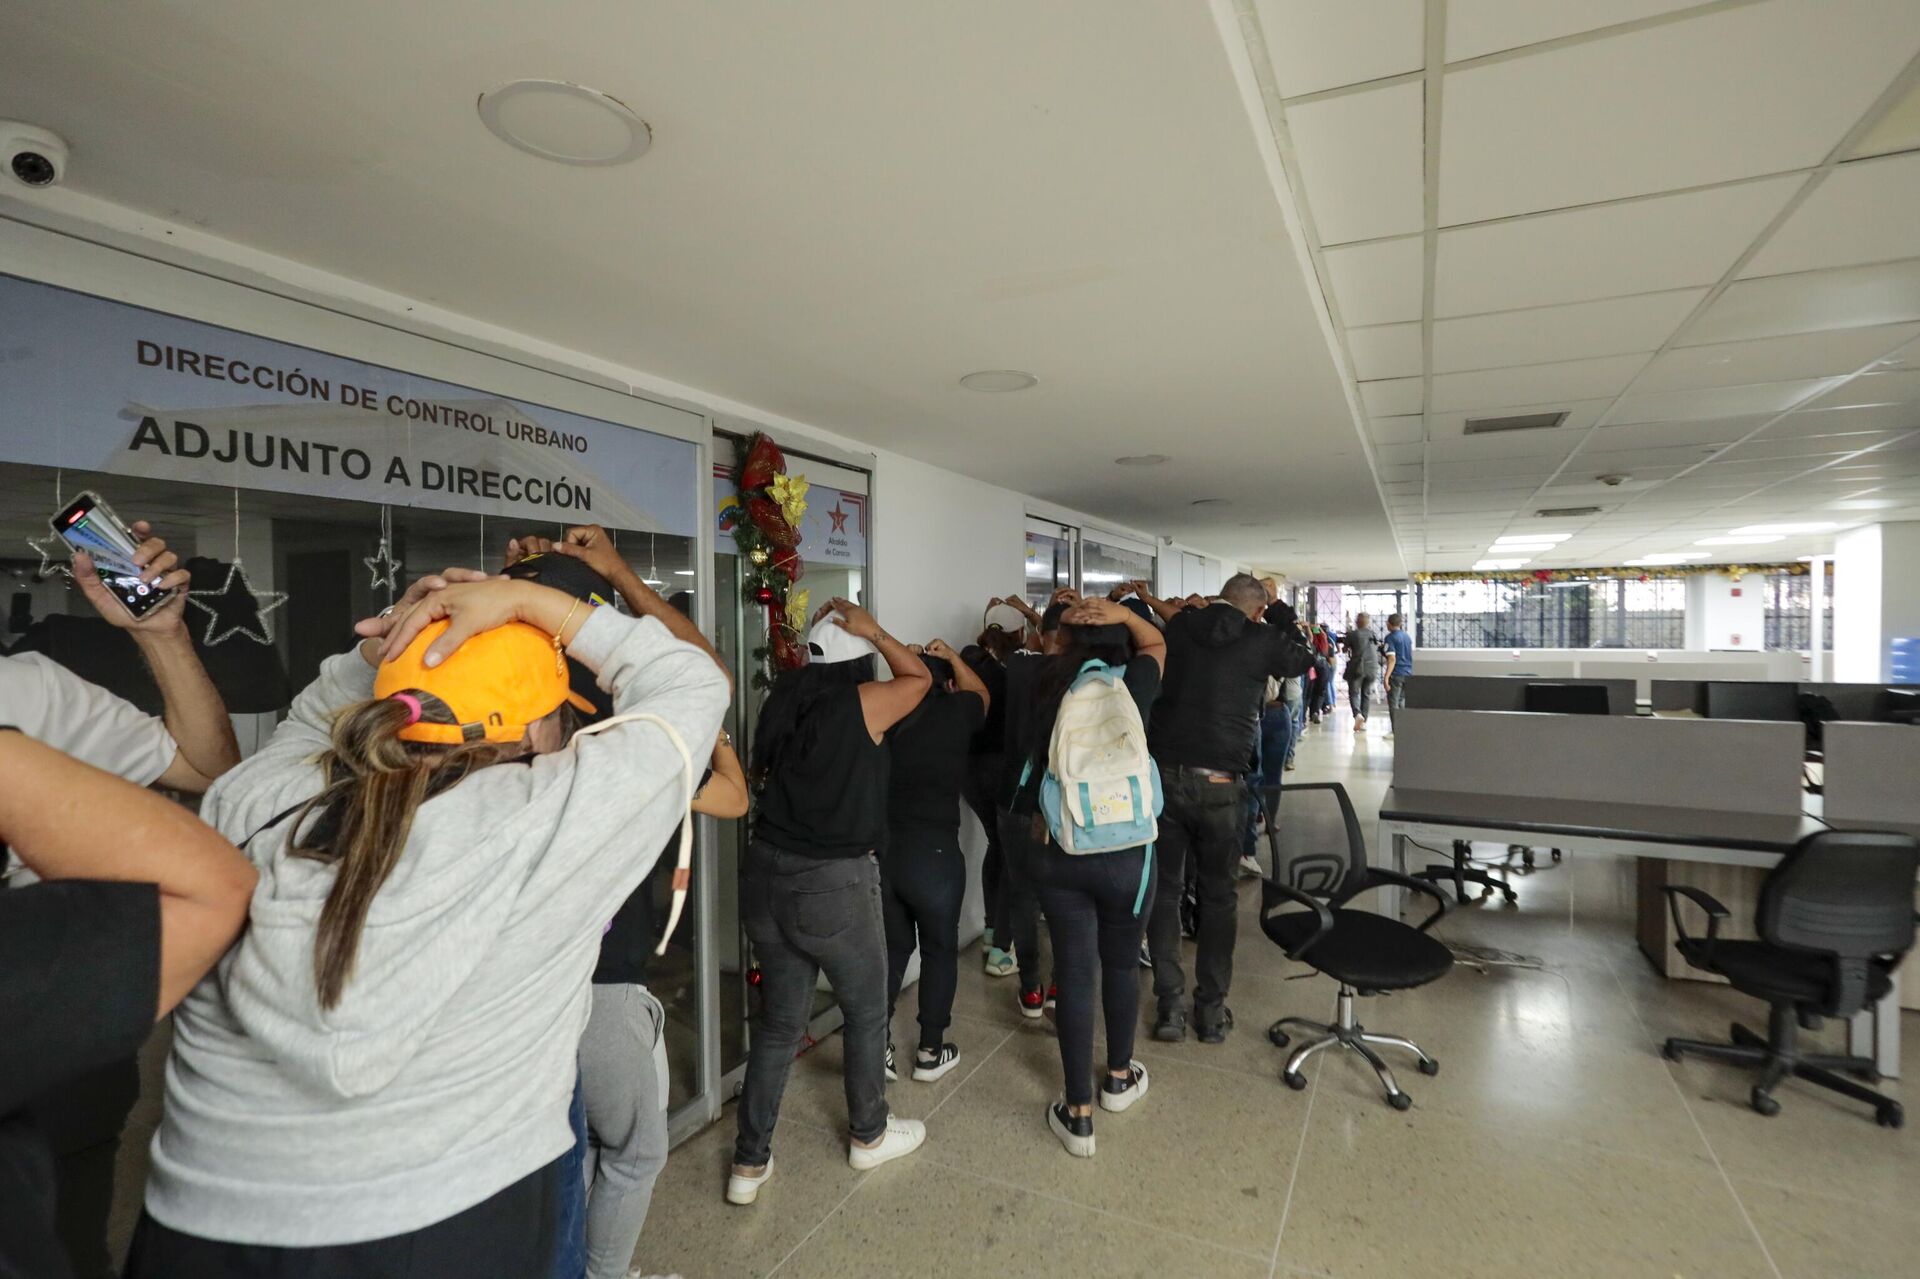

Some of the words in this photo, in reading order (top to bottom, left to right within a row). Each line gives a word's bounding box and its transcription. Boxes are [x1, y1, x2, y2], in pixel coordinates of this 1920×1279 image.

[136, 339, 330, 401] DIRECCIÓN
[340, 383, 379, 411] DE
[386, 394, 500, 436] CONTROL
[506, 420, 588, 453] URBANO
[128, 415, 372, 480] ADJUNTO
[384, 456, 411, 487] A
[421, 460, 592, 511] DIRECCIÓN
